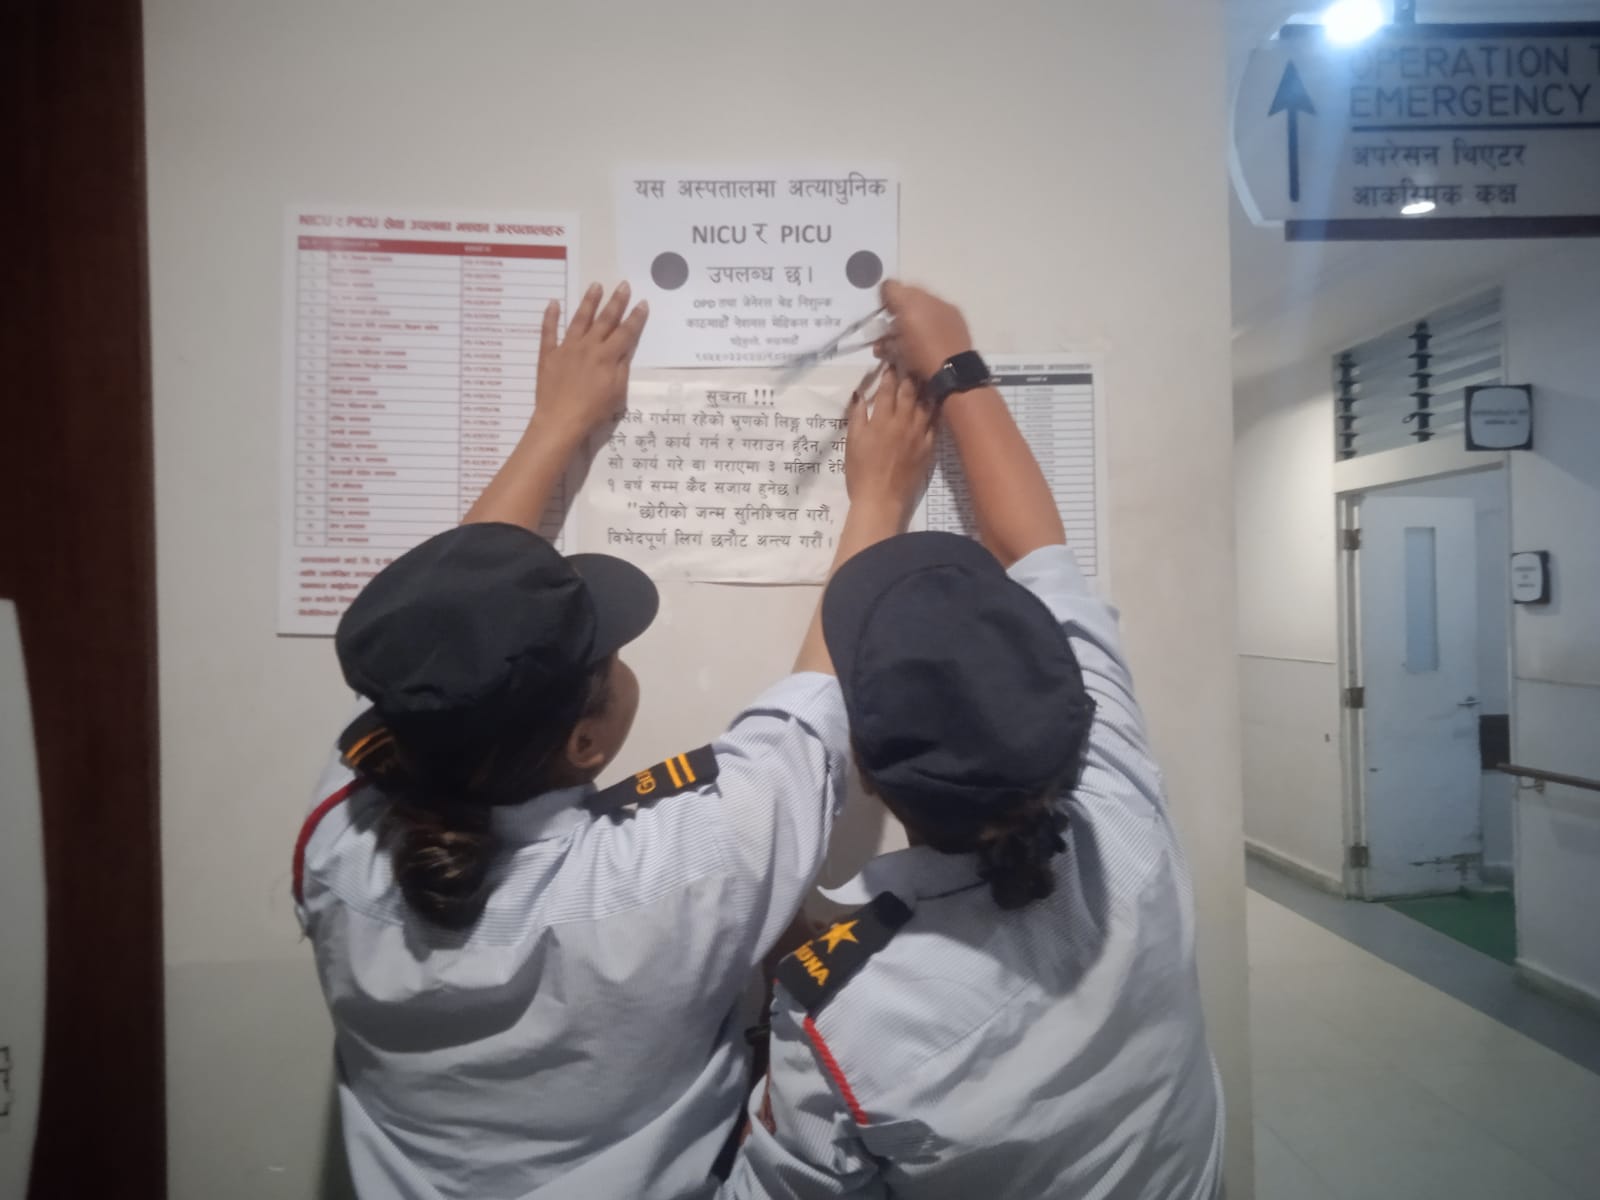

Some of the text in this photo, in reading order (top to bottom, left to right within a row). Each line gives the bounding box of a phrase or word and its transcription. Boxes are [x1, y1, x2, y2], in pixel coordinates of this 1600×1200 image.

[1350, 45, 1569, 80] OPERATION
[1351, 82, 1592, 119] EMERGENCY
[634, 171, 889, 205] यस अस्पतालमा अत्याधुनिक
[1474, 183, 1518, 204] कक्ष
[692, 223, 832, 244] NICU र PICU
[706, 266, 774, 284] उपलब्ध
[649, 408, 686, 425] गर्भमा
[692, 409, 724, 427] रहेको
[635, 430, 657, 453] कुनै
[664, 432, 691, 449] कार्य
[699, 433, 720, 449] गर्न
[727, 438, 735, 451] र
[741, 438, 785, 451] गराउन
[607, 454, 624, 469] सो
[632, 454, 659, 471] कार्य
[667, 455, 684, 472] गरे
[714, 460, 761, 475] गराएमा
[783, 458, 822, 475] महिना
[624, 475, 643, 491] वर्ष
[650, 480, 679, 493] सम्म
[686, 476, 707, 492] कैद
[714, 482, 752, 495] सजाय
[696, 507, 726, 519] जन्म
[734, 504, 800, 525] सुनिश्चित
[607, 528, 667, 550] विभेदपूर्ण
[793, 940, 830, 986] UNA
